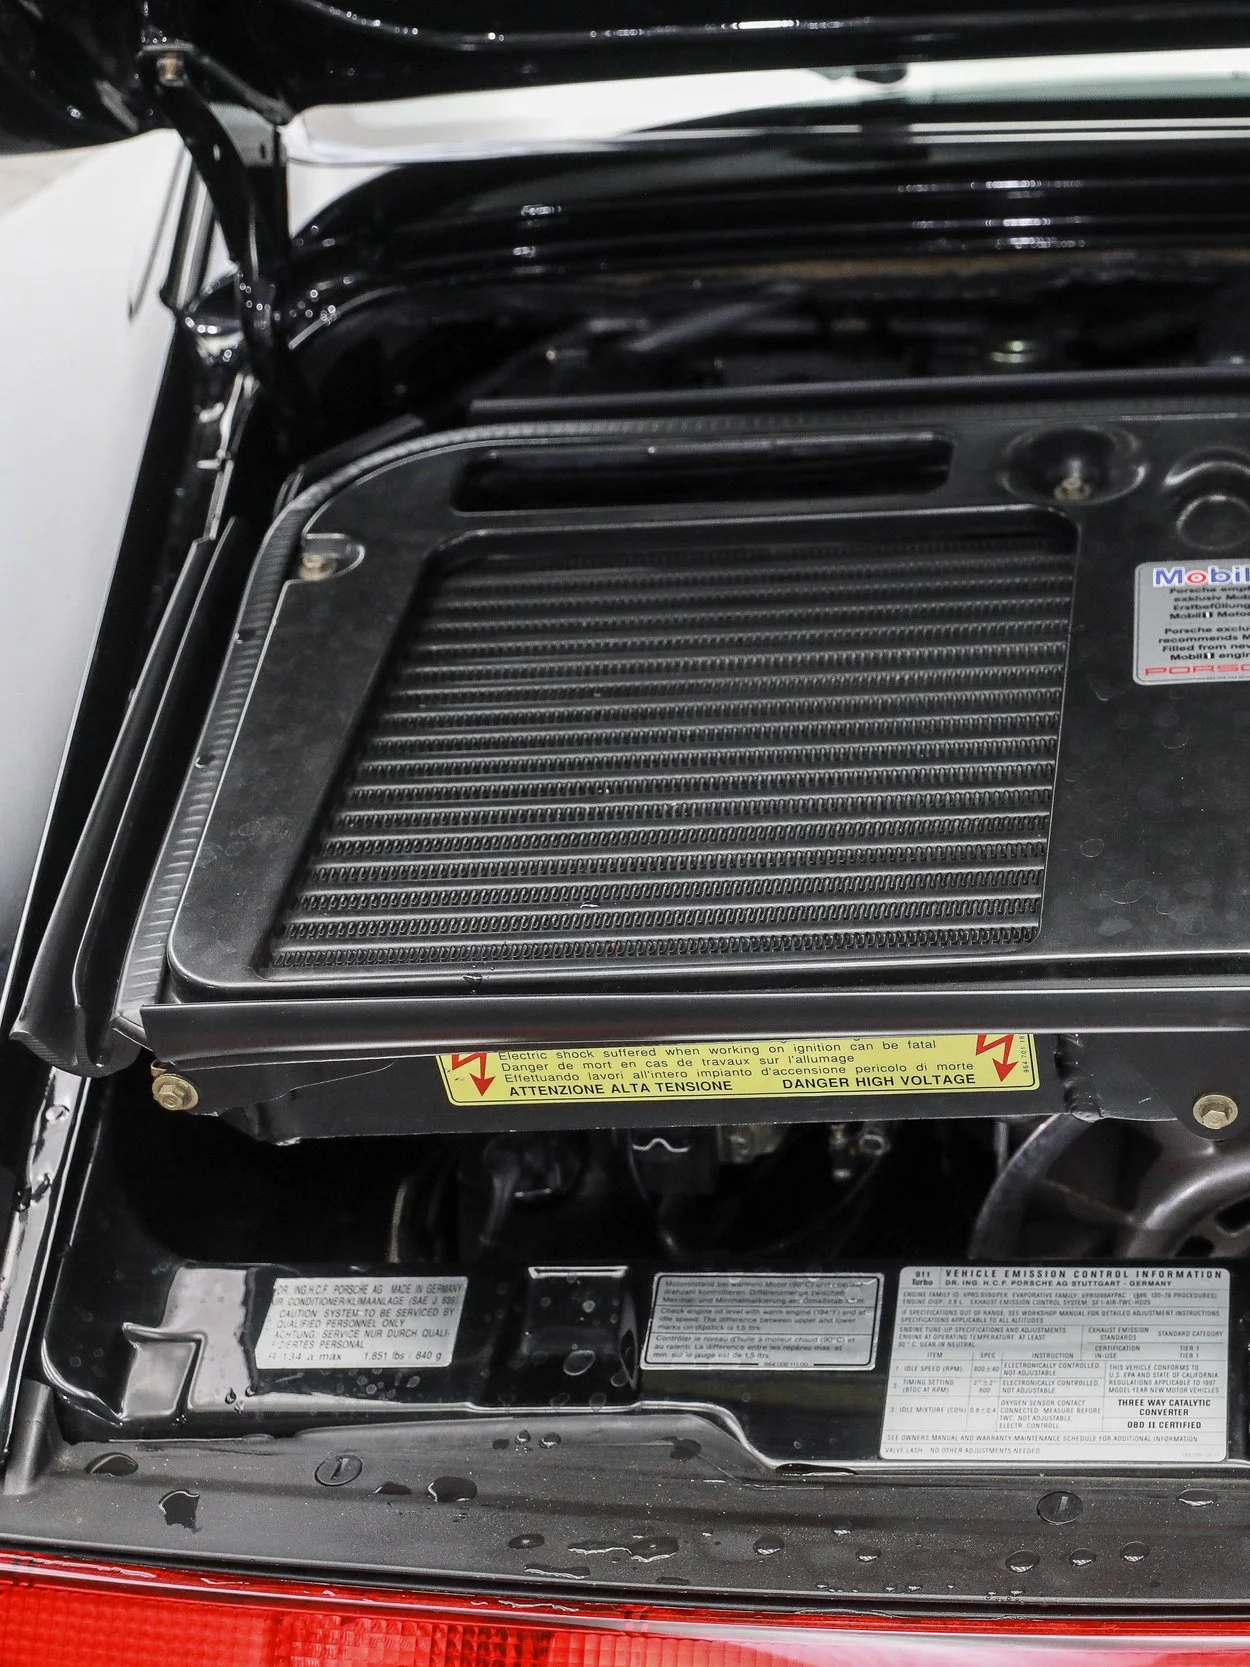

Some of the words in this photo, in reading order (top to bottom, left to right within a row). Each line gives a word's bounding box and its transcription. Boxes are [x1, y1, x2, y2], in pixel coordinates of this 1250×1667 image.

[1155, 567, 1250, 584] Mobil
[1173, 602, 1250, 611] Erstbefüllung
[1163, 644, 1195, 652] Filled
[499, 1051, 548, 1060] Electric
[557, 1050, 594, 1059] shock
[603, 1048, 656, 1058] suffered
[665, 1047, 700, 1055] when
[709, 1045, 760, 1056] working
[794, 1043, 841, 1054] ignition
[850, 1043, 874, 1051] can
[883, 1041, 899, 1050] be
[908, 1040, 936, 1049] fatal
[502, 1062, 548, 1073] Danger
[558, 1061, 573, 1070] de
[583, 1060, 612, 1069] mort
[677, 1058, 693, 1067] de
[702, 1058, 750, 1066] travaux
[759, 1057, 779, 1065] sur
[789, 1055, 854, 1065] l'allumage
[505, 1073, 579, 1083] Effettuando
[588, 1072, 624, 1080] lavori
[633, 1070, 688, 1079] all'intero
[697, 1068, 752, 1079] impianto
[762, 1066, 846, 1076] d'accensione
[856, 1064, 907, 1074] pericolo
[916, 1063, 927, 1071] di
[510, 1084, 604, 1096] ATTENZIONE
[611, 1083, 650, 1094] ALTA
[655, 1081, 732, 1092] TENSIONE
[783, 1078, 849, 1089] DANGER
[856, 1076, 894, 1086] HIGH
[899, 1073, 975, 1085] VOLTAGE
[945, 1270, 997, 1278] VEHICLE
[1004, 1270, 1066, 1278] EMISSION
[1073, 1270, 1129, 1278] CONTROL
[1136, 1270, 1222, 1279] INFORMATION
[334, 1285, 368, 1295] PORSCHE
[373, 1285, 383, 1294] AG
[392, 1284, 412, 1294] MADE
[415, 1284, 422, 1294] IN
[426, 1284, 461, 1294] GERMANY
[324, 1309, 358, 1318] SYSTEM
[364, 1308, 374, 1318] TO
[380, 1308, 390, 1318] BE
[396, 1308, 439, 1318] SERVICED
[444, 1308, 455, 1317] BY
[687, 1309, 712, 1317] engine
[785, 1309, 812, 1317] engine
[325, 1319, 376, 1328] PERSONNEL
[382, 1319, 405, 1328] ONLY
[322, 1329, 359, 1339] SERVICE
[364, 1329, 382, 1339] NUR
[387, 1329, 418, 1339] DURCH
[319, 1339, 365, 1349] PERSONAL
[365, 1352, 388, 1361] 1.851
[416, 1352, 433, 1360] 840
[1118, 1399, 1145, 1407] THREE
[1147, 1399, 1166, 1407] WAY
[1169, 1399, 1211, 1407] CATALYTIC
[1127, 1421, 1145, 1429] OBD
[1148, 1421, 1156, 1429] II
[1158, 1421, 1202, 1429] CERTIFIED
